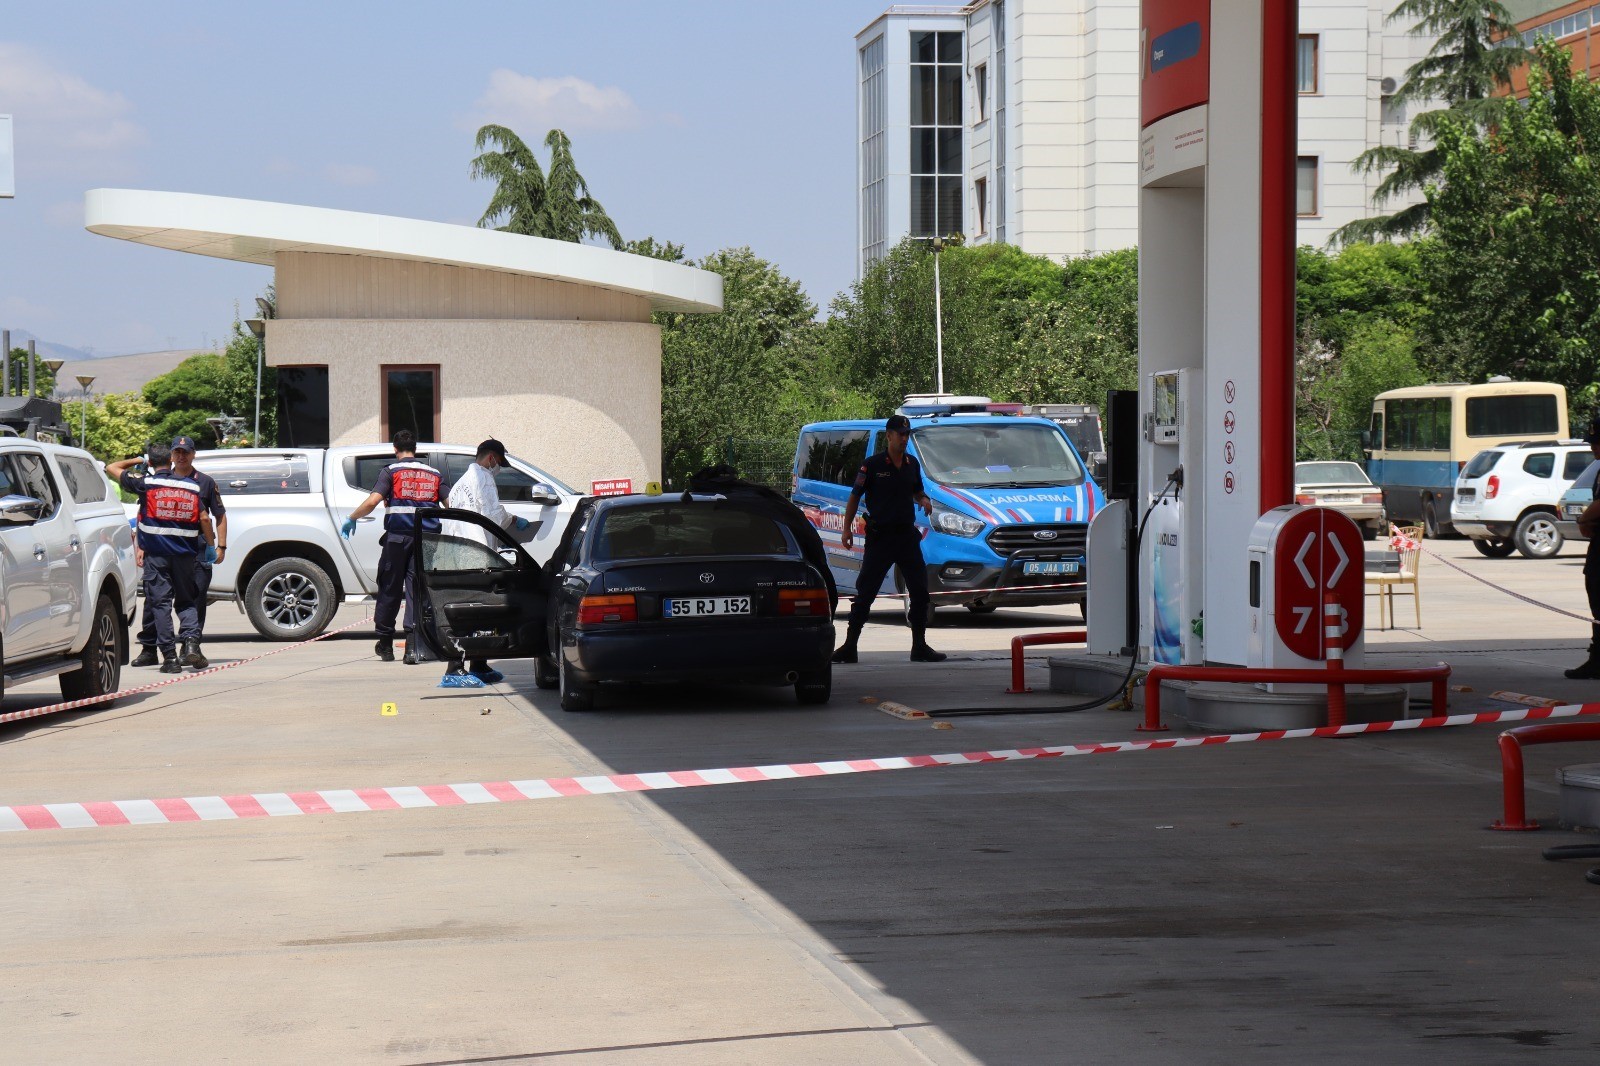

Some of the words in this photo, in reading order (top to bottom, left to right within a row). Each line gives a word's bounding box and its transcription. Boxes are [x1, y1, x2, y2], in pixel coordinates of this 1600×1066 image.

[989, 494, 1075, 505] JANDARMA
[822, 513, 857, 533] JANDAA
[1029, 563, 1040, 572] 05
[1043, 563, 1058, 572] JAA
[1062, 563, 1073, 572] 131
[672, 601, 690, 614] 55
[696, 600, 716, 614] RJ
[723, 598, 749, 613] 152
[1292, 606, 1313, 634] 7
[386, 705, 392, 713] 2
